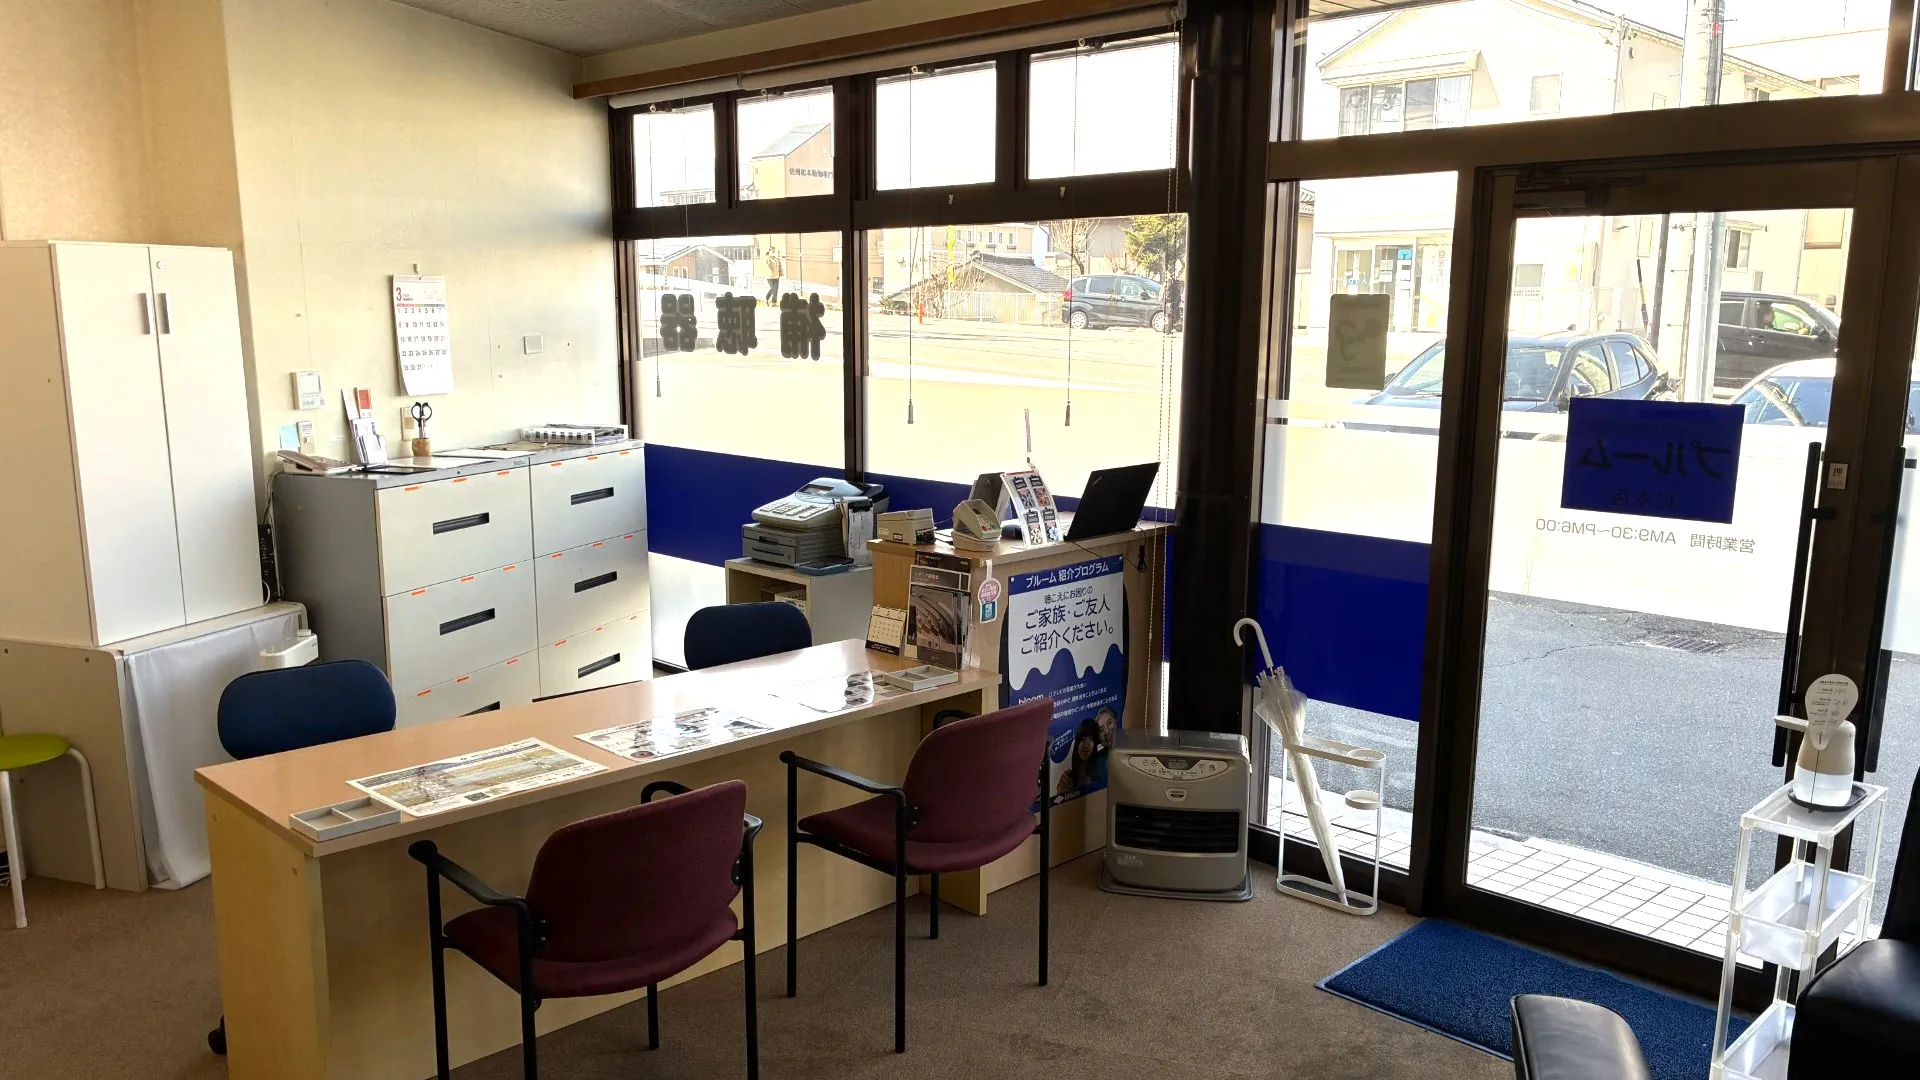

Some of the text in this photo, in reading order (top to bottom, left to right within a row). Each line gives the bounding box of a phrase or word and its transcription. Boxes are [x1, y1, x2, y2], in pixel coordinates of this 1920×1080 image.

[396, 287, 402, 301] 3
[1025, 561, 1110, 589] ブルーム 紹介プログラム
[1044, 585, 1094, 604] 聴こえにお困りの
[1021, 620, 1114, 655] ご紹介ください。
